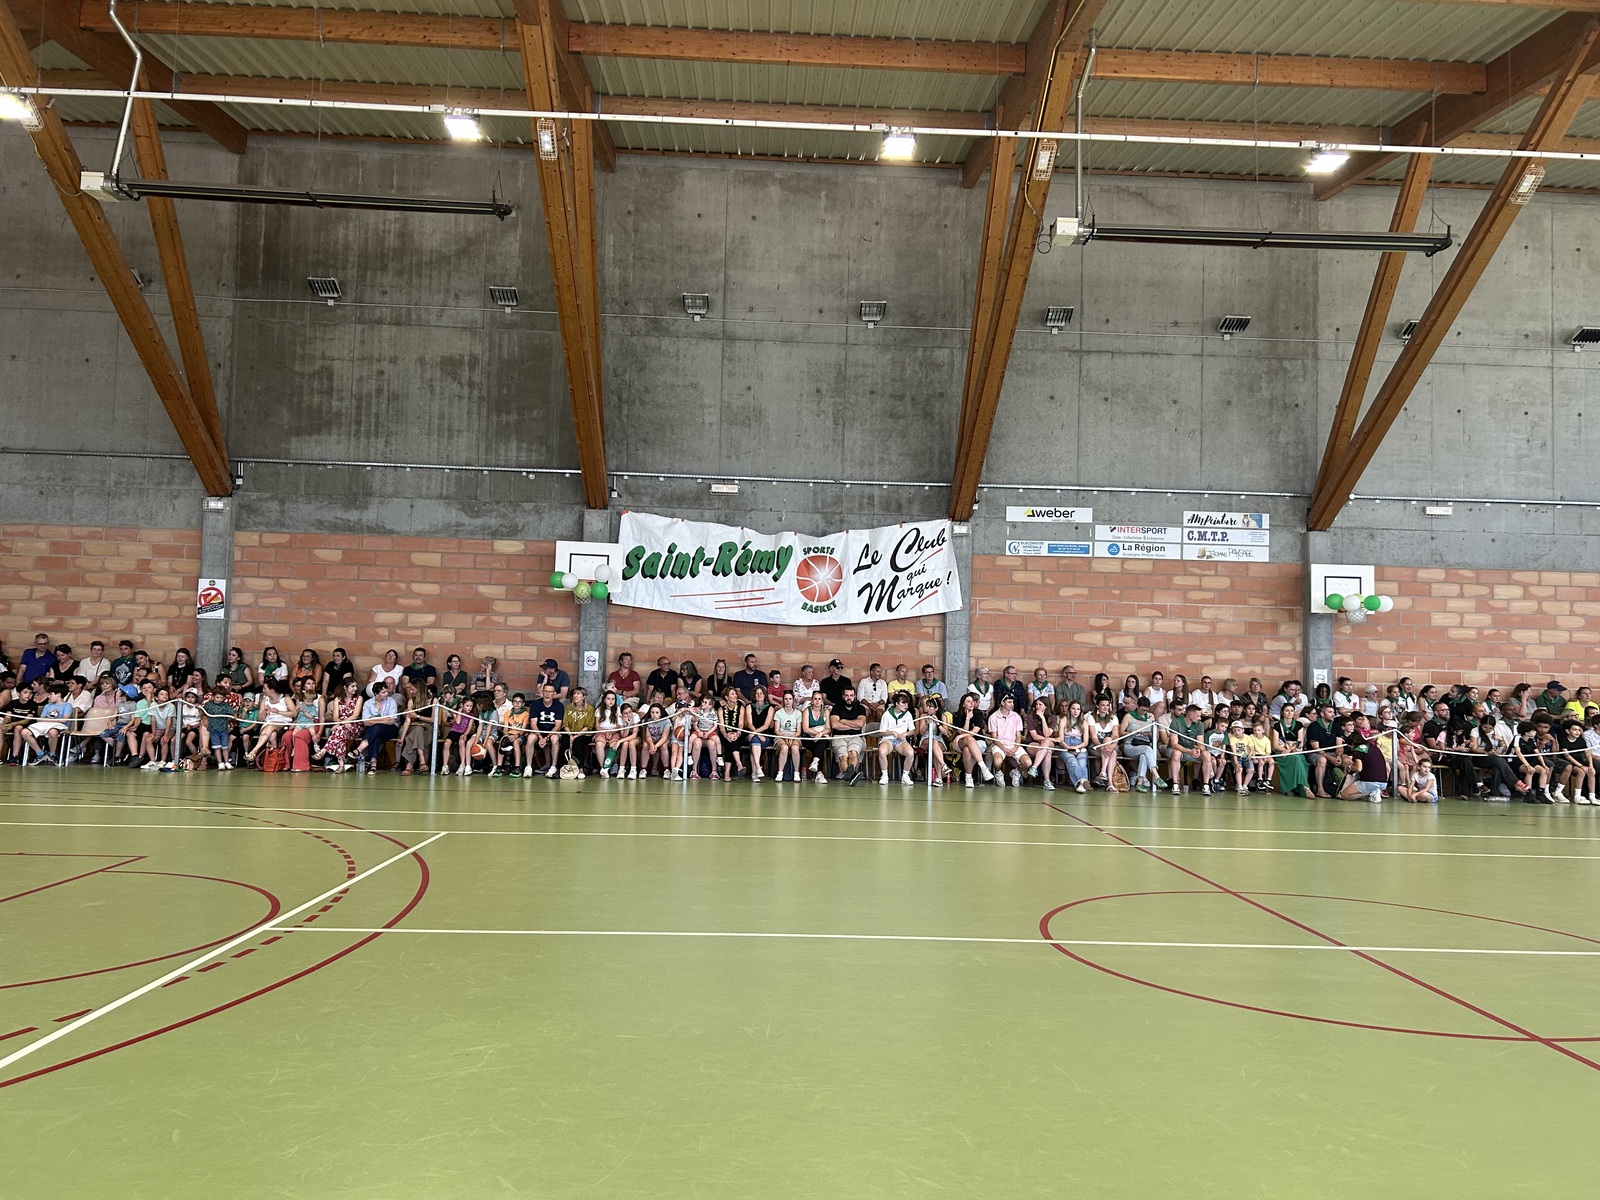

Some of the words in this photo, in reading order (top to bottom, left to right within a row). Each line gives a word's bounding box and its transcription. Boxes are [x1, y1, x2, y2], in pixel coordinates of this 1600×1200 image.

[1035, 507, 1076, 518] weber
[1117, 526, 1167, 535] INTERSPORT
[1187, 530, 1229, 542] C.M.T.P.
[802, 546, 835, 555] SPORTS
[853, 543, 883, 575] Le
[889, 527, 947, 572] Club
[1122, 543, 1132, 551] La
[1134, 543, 1166, 553] Région
[622, 540, 794, 582] Saint-Rémy
[906, 563, 927, 586] qui
[857, 575, 943, 615] Marque
[801, 600, 837, 613] BASKET
